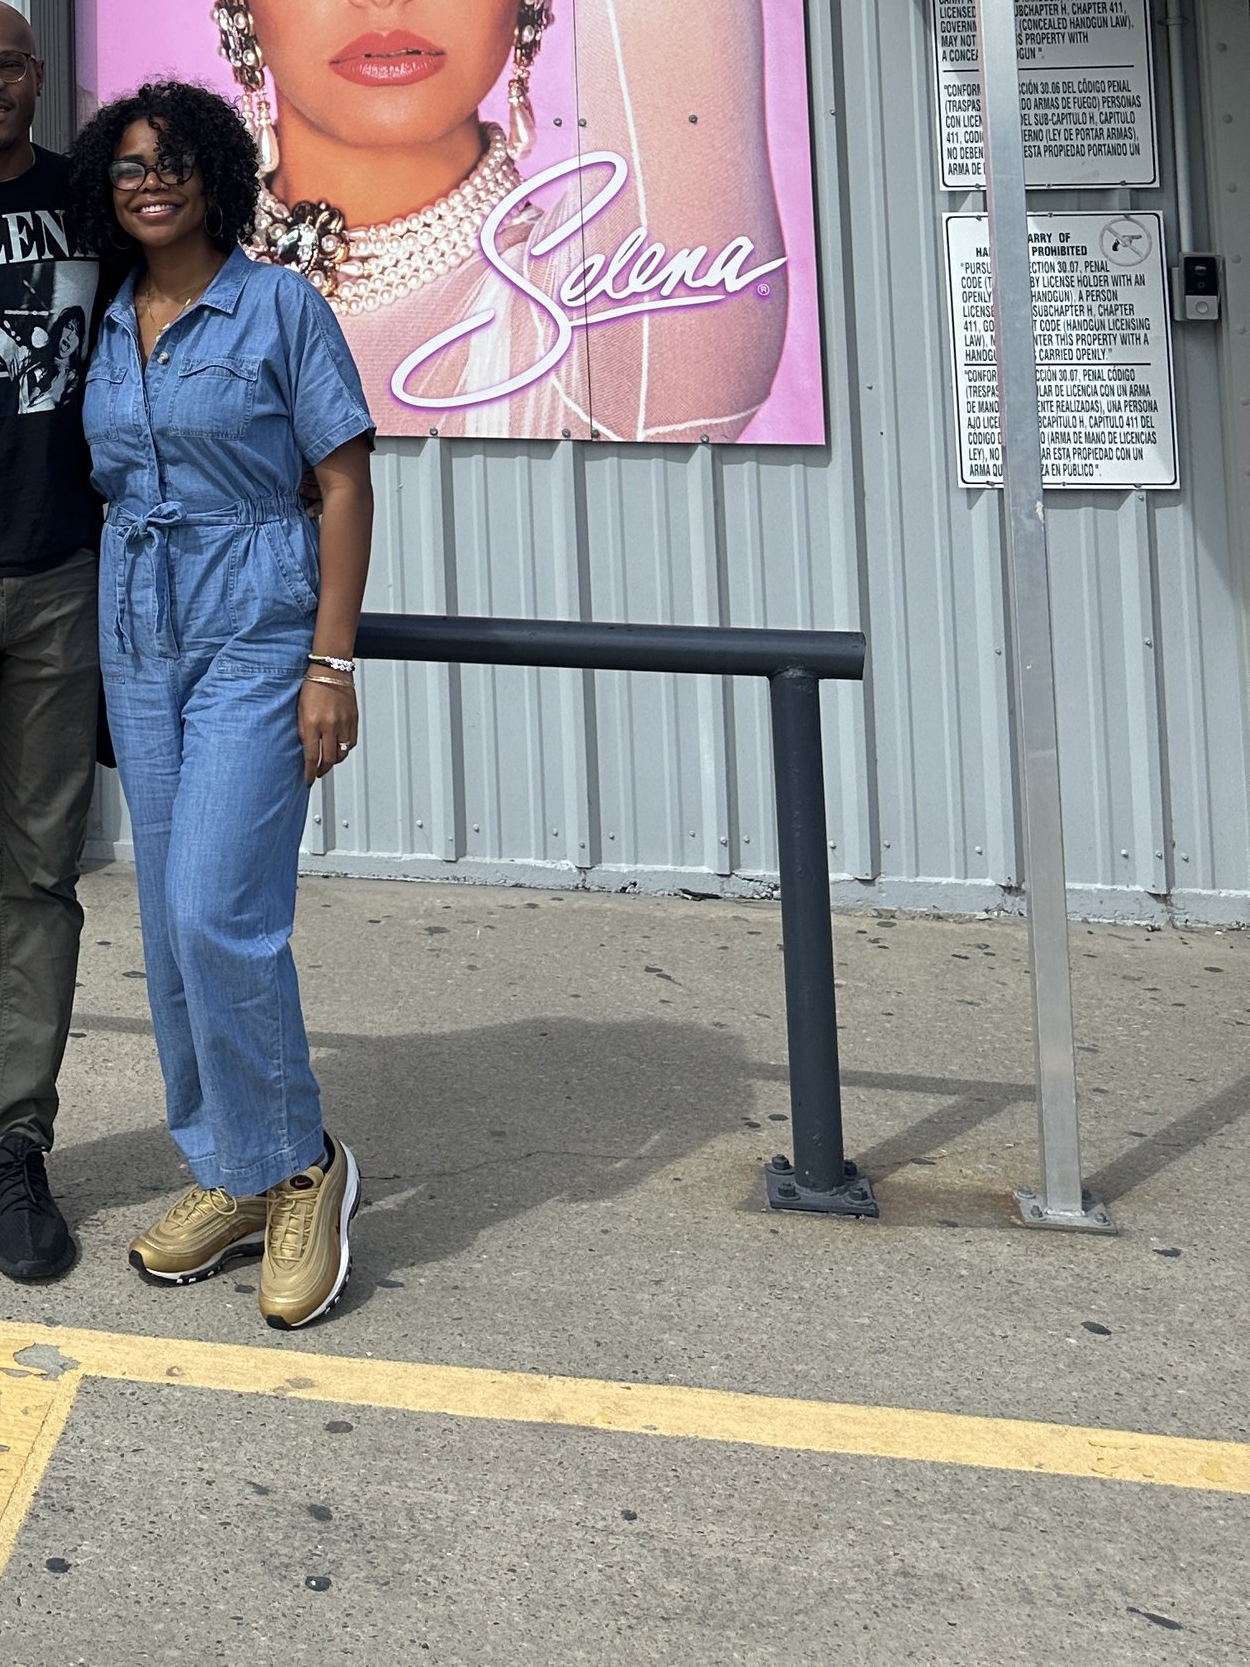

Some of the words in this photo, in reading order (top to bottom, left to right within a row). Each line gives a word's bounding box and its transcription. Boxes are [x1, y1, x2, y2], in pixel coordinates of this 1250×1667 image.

[1071, 2, 1107, 15] CHAPTER
[1109, 1, 1127, 14] 411,
[1019, 17, 1068, 33] (CONCEALED
[1069, 16, 1108, 29] HANDGUN
[941, 35, 958, 47] MAY
[960, 34, 976, 47] NOT
[1025, 32, 1066, 45] PROPERTY
[1068, 31, 1088, 44] WITH
[942, 50, 947, 62] A
[1061, 81, 1076, 94] DEL
[1107, 80, 1131, 93] PENAL
[945, 99, 981, 114] (TRASPAS
[1033, 96, 1060, 110] ARMAS
[1061, 96, 1072, 109] DE
[1073, 96, 1100, 111] FUEGO)
[1102, 95, 1142, 109] PERSONAS
[946, 115, 961, 128] CON
[1045, 128, 1061, 144] (LEY
[1063, 128, 1074, 141] DE
[1075, 127, 1105, 141] PORTAR
[947, 147, 957, 159] NO
[1024, 145, 1041, 158] ESTA
[1043, 144, 1086, 158] PROPIEDAD
[1088, 143, 1128, 156] PORTANDO
[1129, 143, 1140, 155] UN
[948, 163, 970, 175] ARMA
[971, 162, 981, 175] DE
[1027, 233, 1052, 244] ARRY
[1058, 232, 1071, 243] OF
[1032, 245, 1087, 257] PROHIBITED
[1084, 260, 1110, 273] PENAL
[961, 276, 982, 289] CODE
[1042, 275, 1075, 288] LICENSE
[1077, 274, 1109, 287] HOLDER
[1111, 274, 1132, 286] WITH
[1134, 273, 1146, 286] AN
[962, 290, 992, 303] OPENLY
[1078, 290, 1084, 302] A
[1085, 289, 1118, 302] PERSON
[963, 305, 994, 318] LICENSE
[1032, 304, 1084, 317] SUBCHAPTER
[1098, 303, 1135, 316] CHAPTER
[964, 320, 981, 334] 411,
[1039, 319, 1061, 332] CODE
[1063, 318, 1106, 334] (HANDGUN
[1108, 317, 1150, 331] LICENSING
[1055, 334, 1073, 346] THIS
[1076, 333, 1117, 346] PROPERTY
[1119, 333, 1141, 345] WITH
[1143, 333, 1149, 345] A
[1039, 348, 1073, 361] CARRIED
[1082, 368, 1106, 381] PENAL
[1107, 366, 1135, 381] CÓDIGO
[1055, 384, 1064, 397] DE
[1066, 384, 1098, 397] LICENCIA
[1100, 384, 1115, 397] CON
[1117, 384, 1127, 397] UN
[1129, 384, 1151, 397] ARMA
[967, 401, 975, 413] DE
[1107, 400, 1122, 413] UNA
[1124, 399, 1158, 413] PERSONA
[967, 416, 981, 429] AJO
[1126, 416, 1138, 428] 411
[1140, 416, 1155, 428] DEL
[1047, 431, 1071, 446] (ARMA
[1073, 431, 1082, 444] DE
[1084, 431, 1106, 444] MANO
[1108, 431, 1118, 444] DE
[1119, 431, 1157, 445] LICENCIAS
[989, 447, 1000, 460] NO
[1053, 447, 1071, 460] ESTA
[1072, 447, 1114, 461] PROPIEDAD
[1115, 447, 1131, 460] CON
[1132, 447, 1144, 460] UN
[970, 463, 991, 476] ARMA
[992, 463, 1002, 477] QU
[1051, 463, 1061, 476] EN
